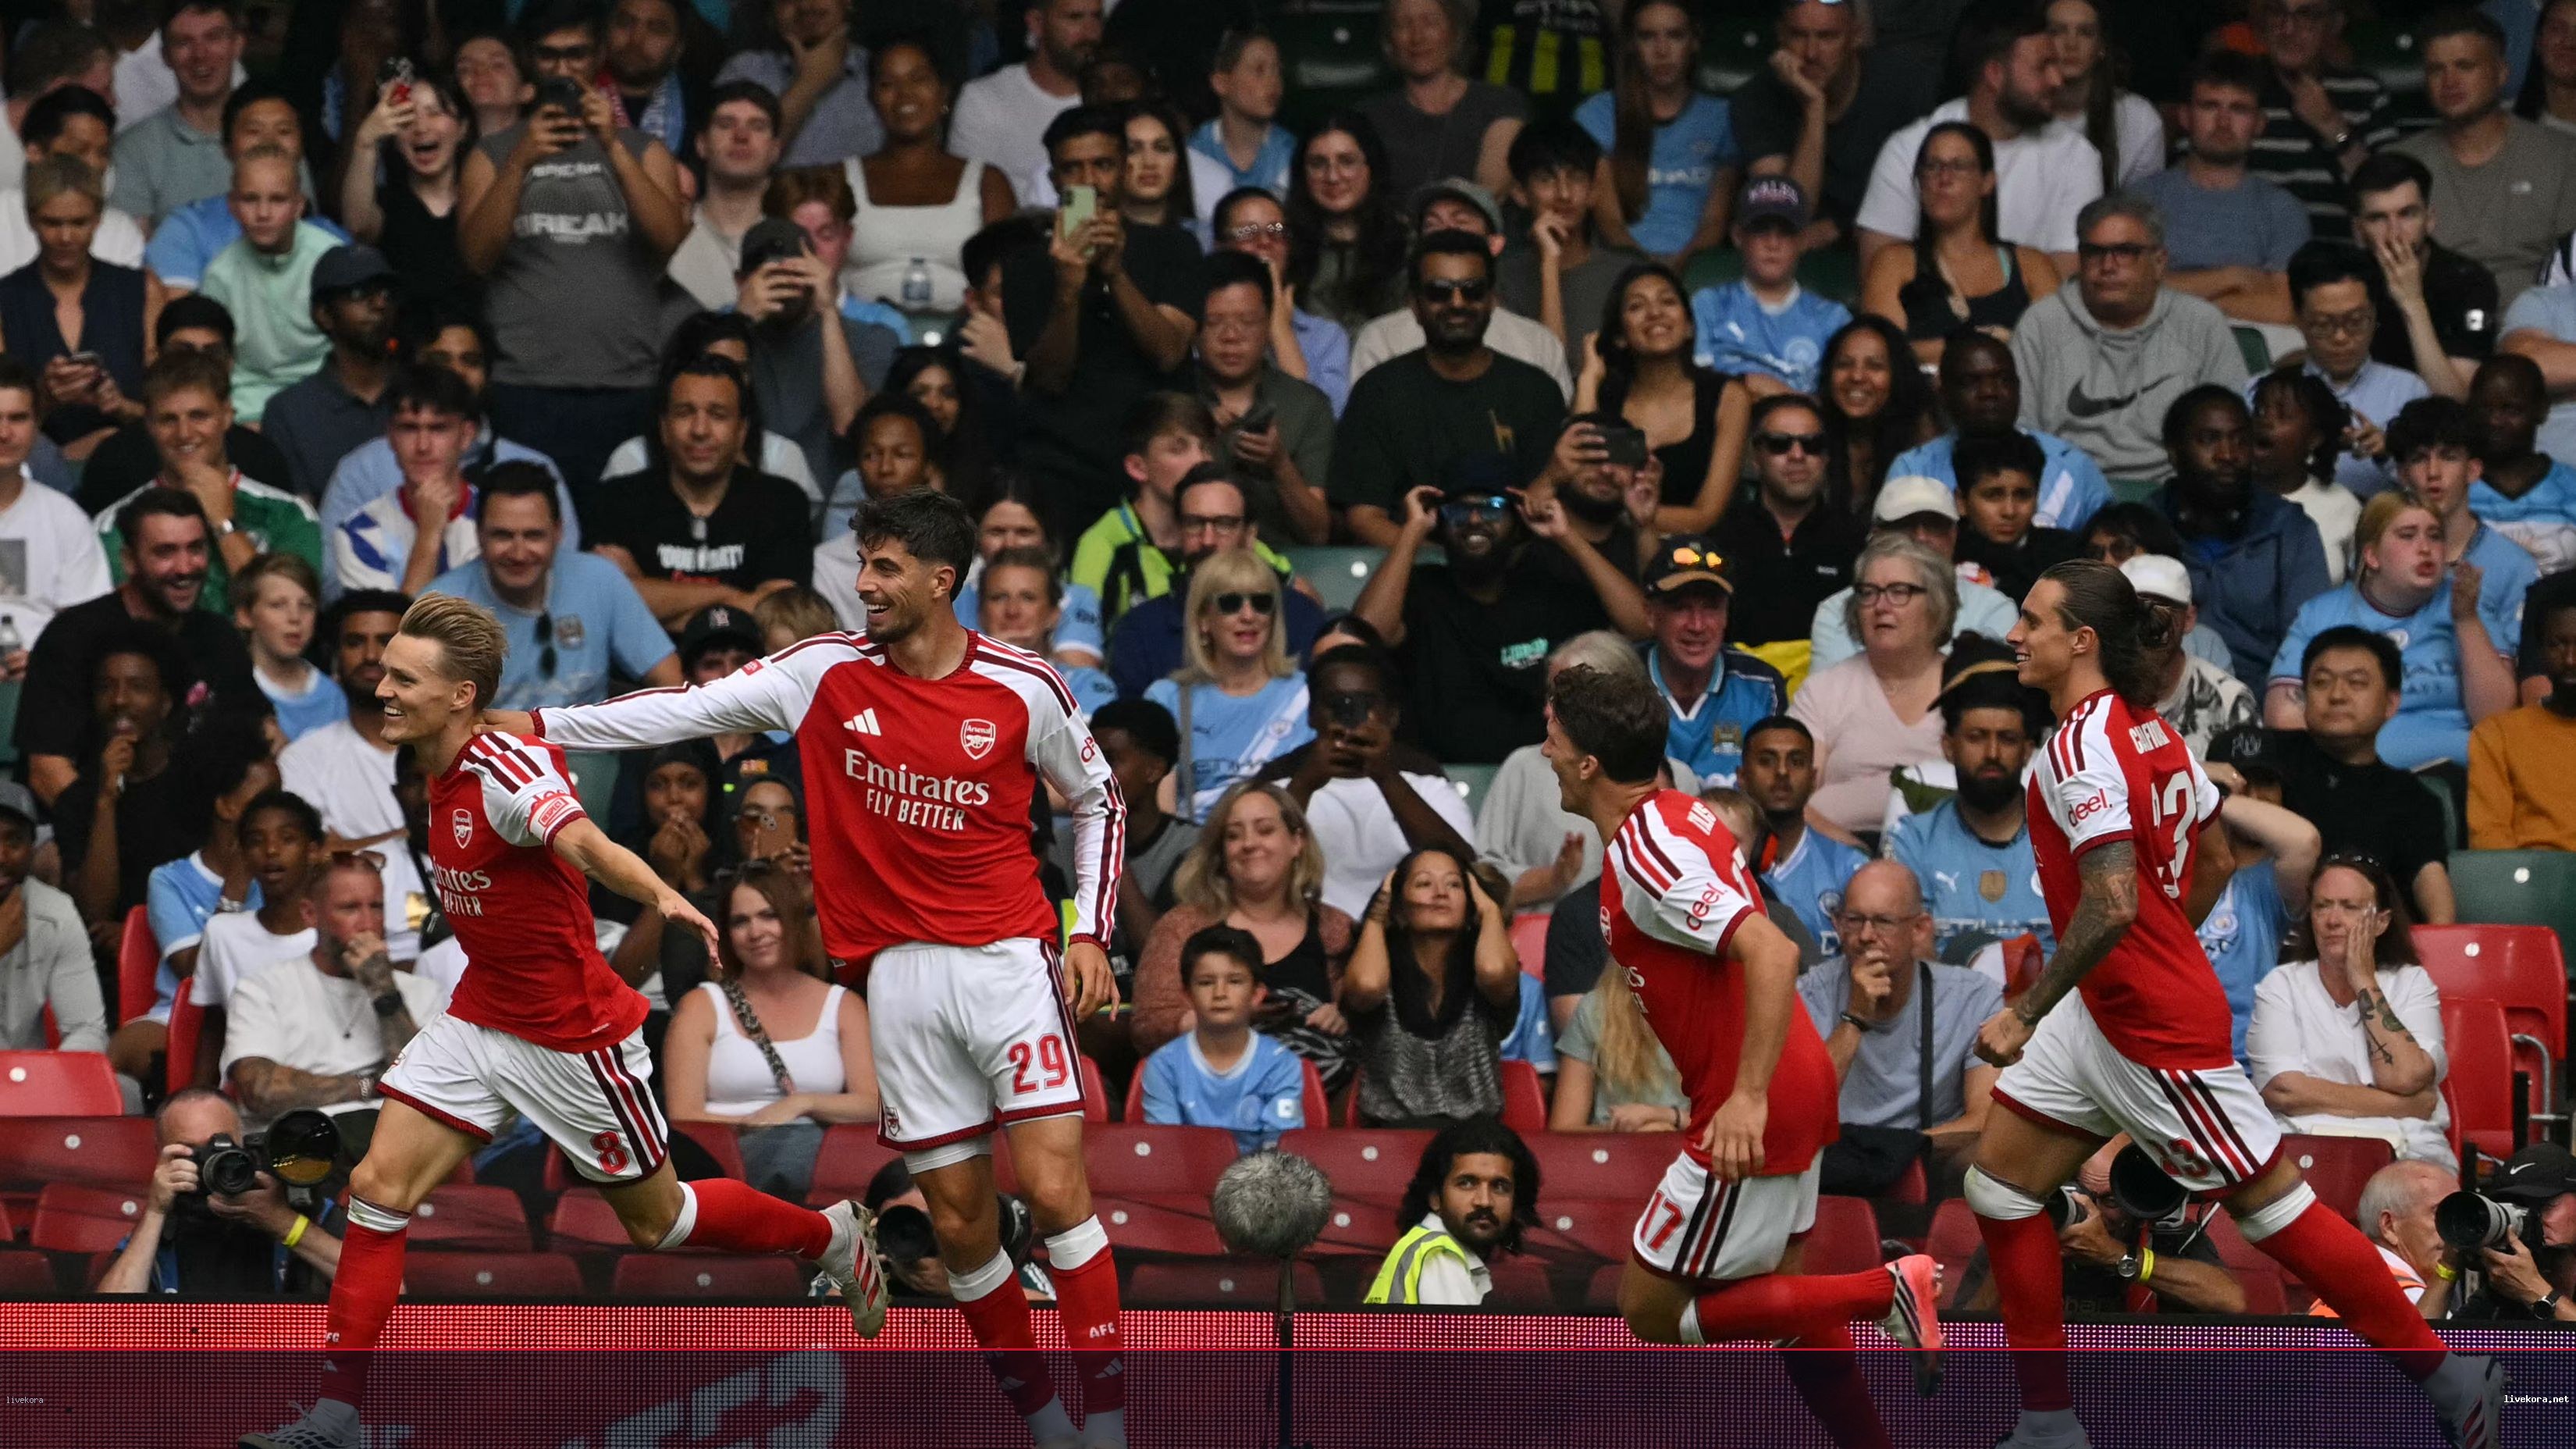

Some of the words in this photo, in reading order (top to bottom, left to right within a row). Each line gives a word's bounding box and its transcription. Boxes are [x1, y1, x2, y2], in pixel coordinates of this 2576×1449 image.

[845, 748, 989, 806] Emirates
[866, 789, 893, 817] FLY
[898, 799, 966, 831] BETTER
[1007, 1032, 1070, 1096] 29
[589, 1130, 630, 1175] 8
[1640, 1190, 1686, 1253] 17
[326, 1332, 340, 1343] FC
